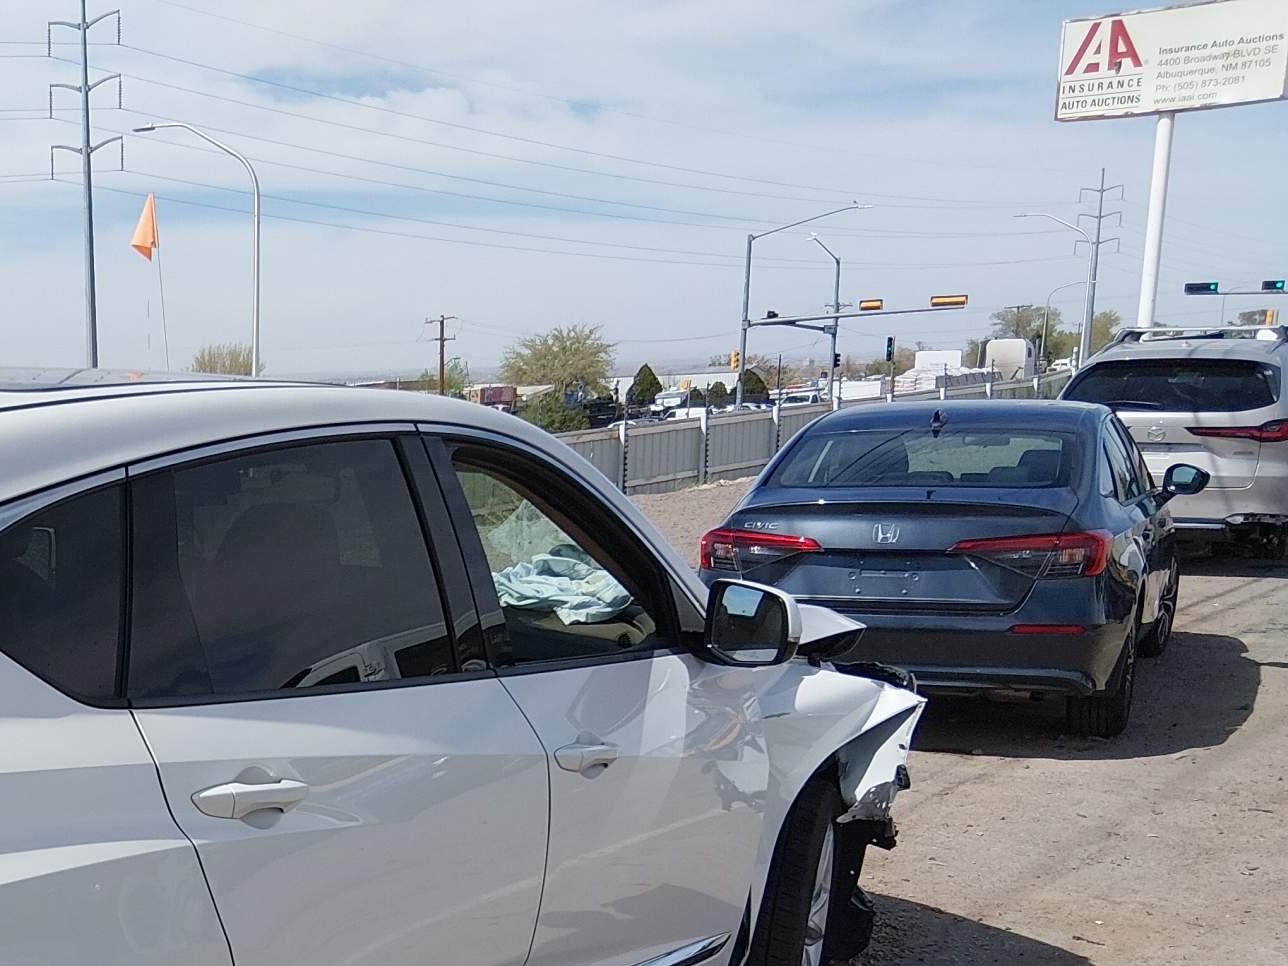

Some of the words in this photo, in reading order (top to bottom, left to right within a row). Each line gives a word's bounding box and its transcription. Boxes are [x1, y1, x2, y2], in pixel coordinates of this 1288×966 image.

[1158, 42, 1208, 55] Insurance
[1211, 39, 1235, 48] Auto
[1238, 33, 1285, 44] Auctions
[1233, 46, 1261, 58] BLVD
[1263, 44, 1279, 54] SE
[1221, 63, 1238, 72] NM
[1241, 58, 1272, 68] 87105
[1062, 78, 1143, 95] INSURANCE
[1173, 80, 1199, 91] (505)
[1201, 75, 1246, 88] 873-2081
[1061, 99, 1088, 111] AUTO
[1090, 94, 1141, 107] AUCTIONS
[744, 521, 779, 529] CIVIC
